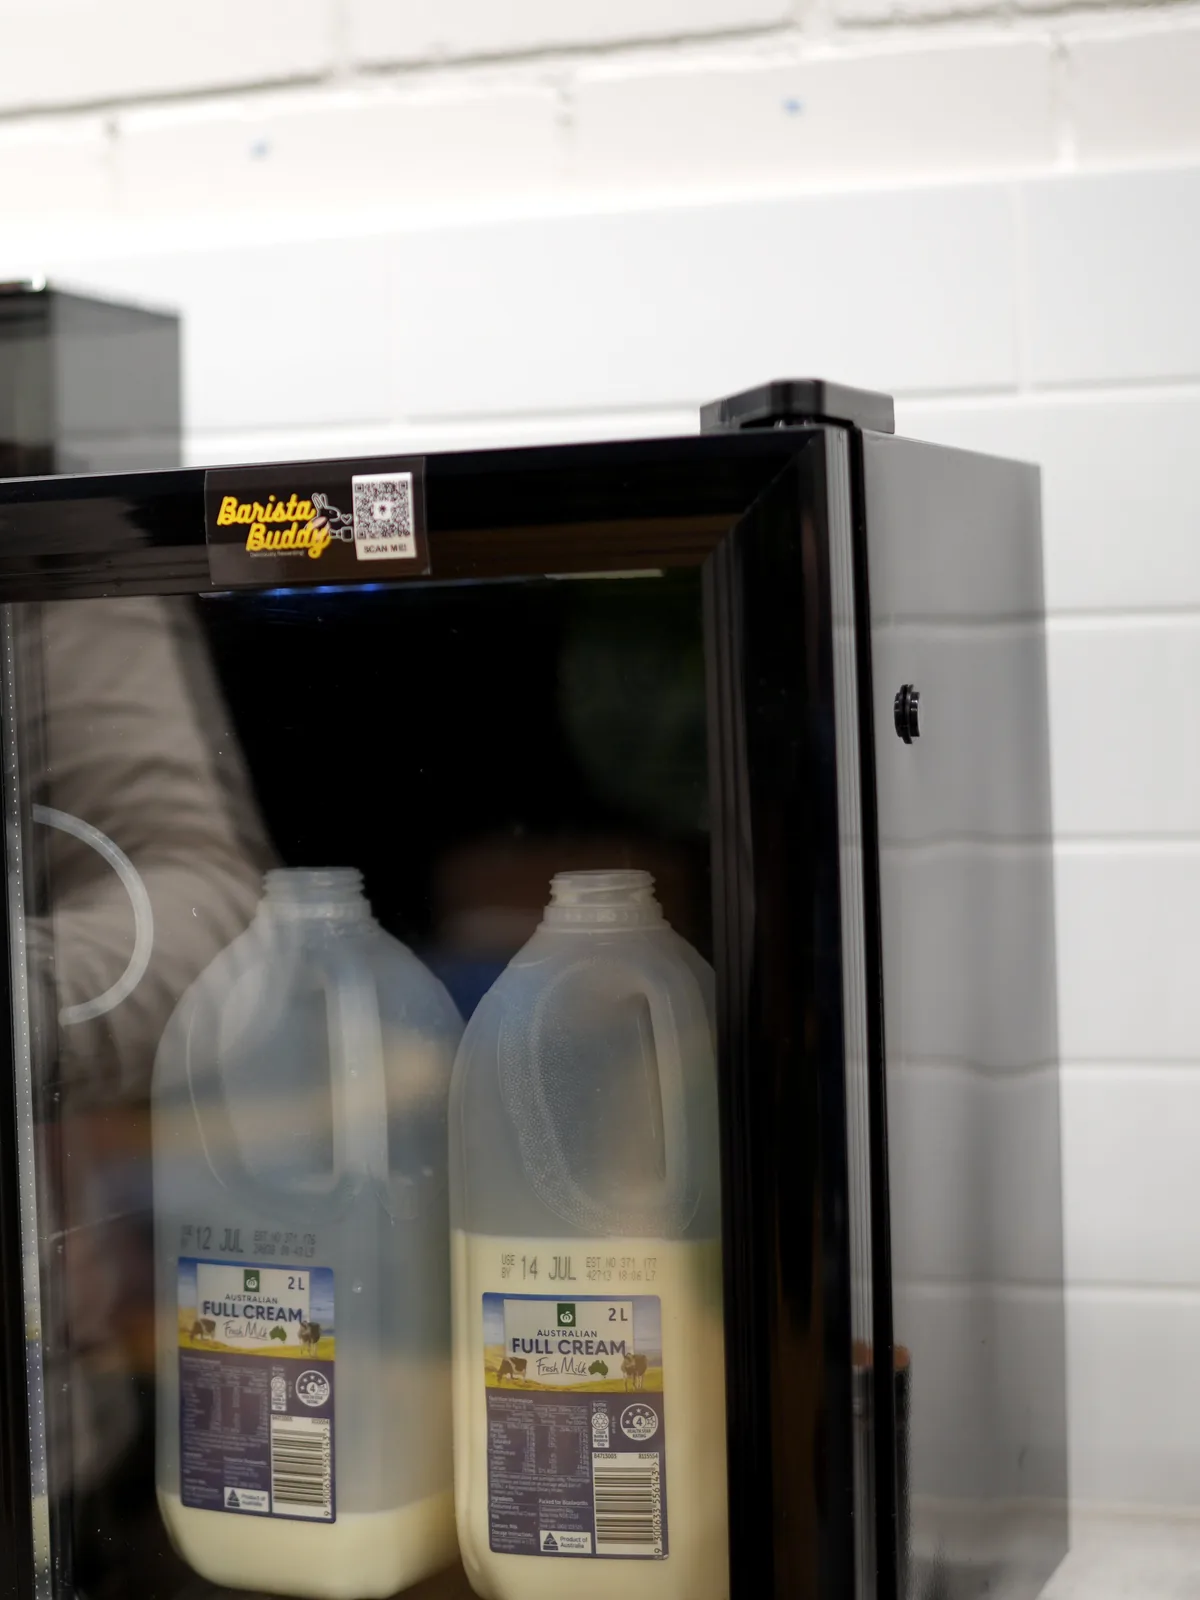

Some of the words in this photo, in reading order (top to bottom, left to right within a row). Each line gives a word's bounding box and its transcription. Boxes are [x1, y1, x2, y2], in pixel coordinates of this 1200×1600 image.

[217, 493, 317, 526] Barista
[246, 521, 332, 559] Buddy
[363, 544, 388, 554] SCAN
[196, 1225, 212, 1251] 12
[219, 1227, 244, 1253] JUL
[501, 1254, 516, 1266] USE
[520, 1254, 539, 1281] 14
[548, 1255, 577, 1281] JUL
[585, 1256, 602, 1269] EST
[501, 1266, 512, 1279] BY
[287, 1276, 296, 1291] 2
[298, 1277, 306, 1291] L
[224, 1293, 279, 1305] AUSTRALIAN
[202, 1300, 240, 1319] FULL
[242, 1304, 302, 1324] CREAM
[608, 1307, 617, 1322] 2
[620, 1307, 629, 1322] L
[536, 1329, 598, 1338] AUSTRALIAN
[511, 1337, 554, 1355] FULL
[557, 1339, 627, 1357] CREAM
[535, 1356, 561, 1376] Fresh
[560, 1356, 588, 1377] Milk
[308, 1383, 318, 1395] 4
[635, 1416, 644, 1427] 4
